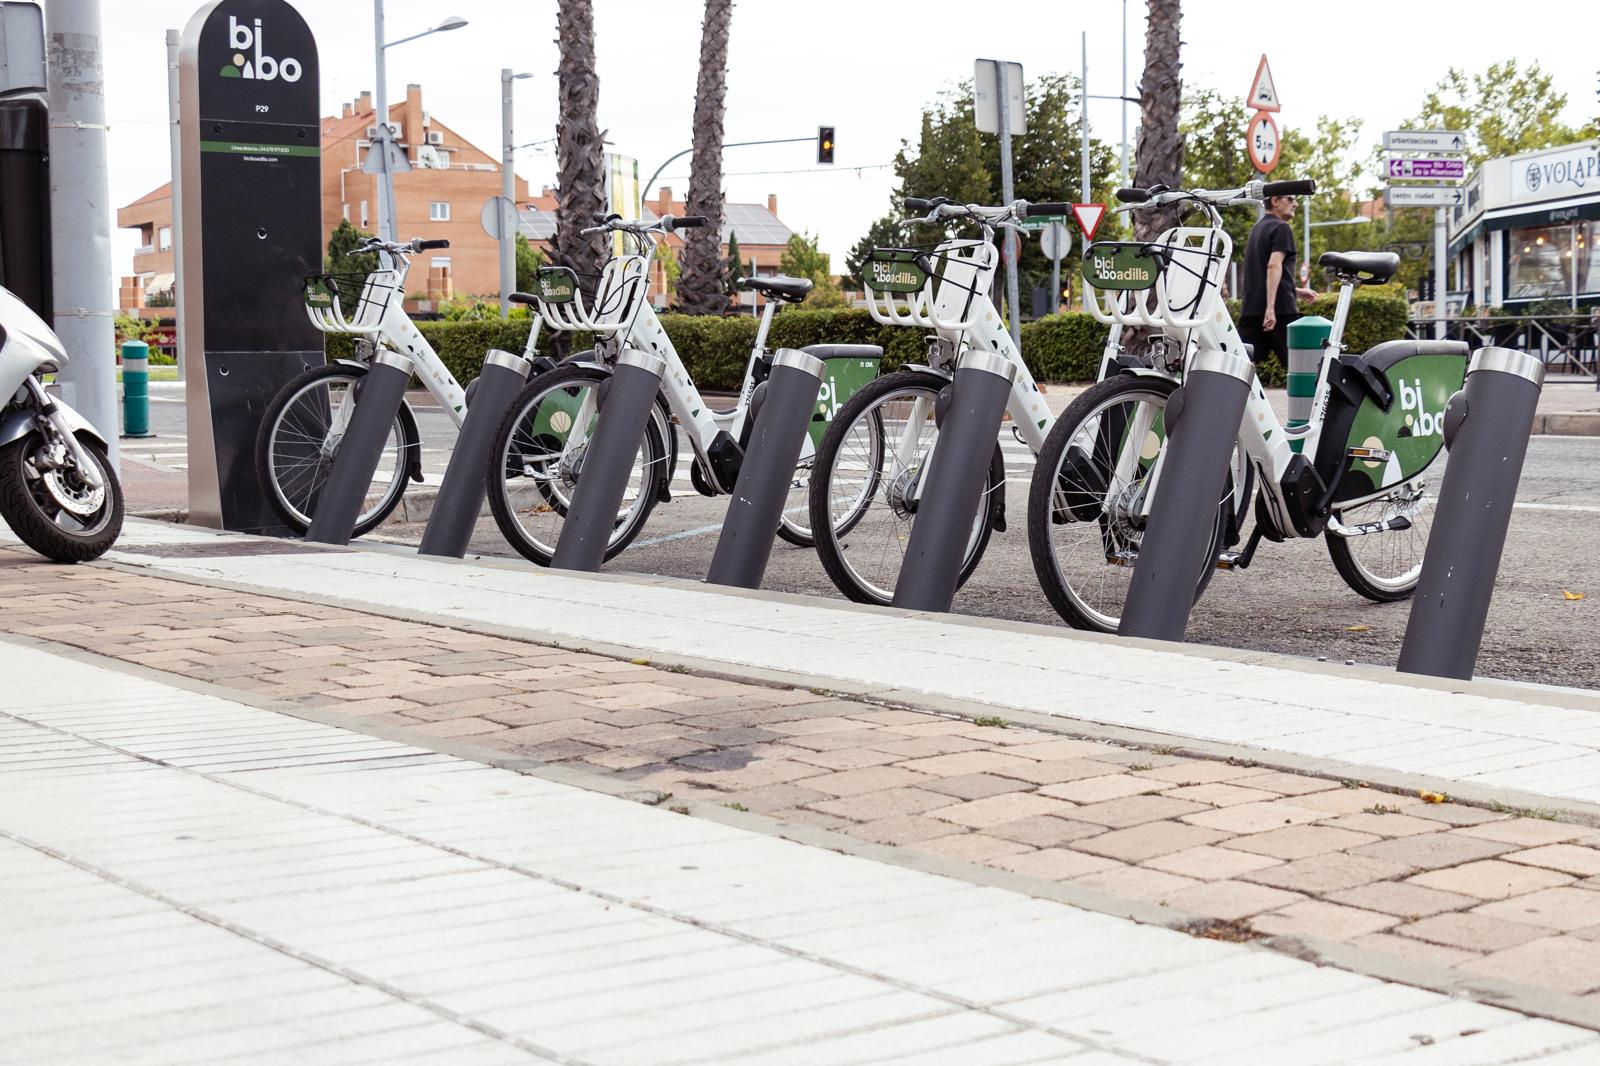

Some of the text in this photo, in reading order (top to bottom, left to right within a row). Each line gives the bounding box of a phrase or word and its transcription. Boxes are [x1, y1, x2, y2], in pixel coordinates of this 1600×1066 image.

[255, 104, 270, 113] P29
[1391, 136, 1438, 145] urbanizaciones
[1392, 192, 1435, 200] centro ciudad
[872, 260, 890, 273] bici
[1094, 255, 1115, 270] bici
[879, 271, 917, 285] boadilla
[1101, 267, 1149, 281] boadilla
